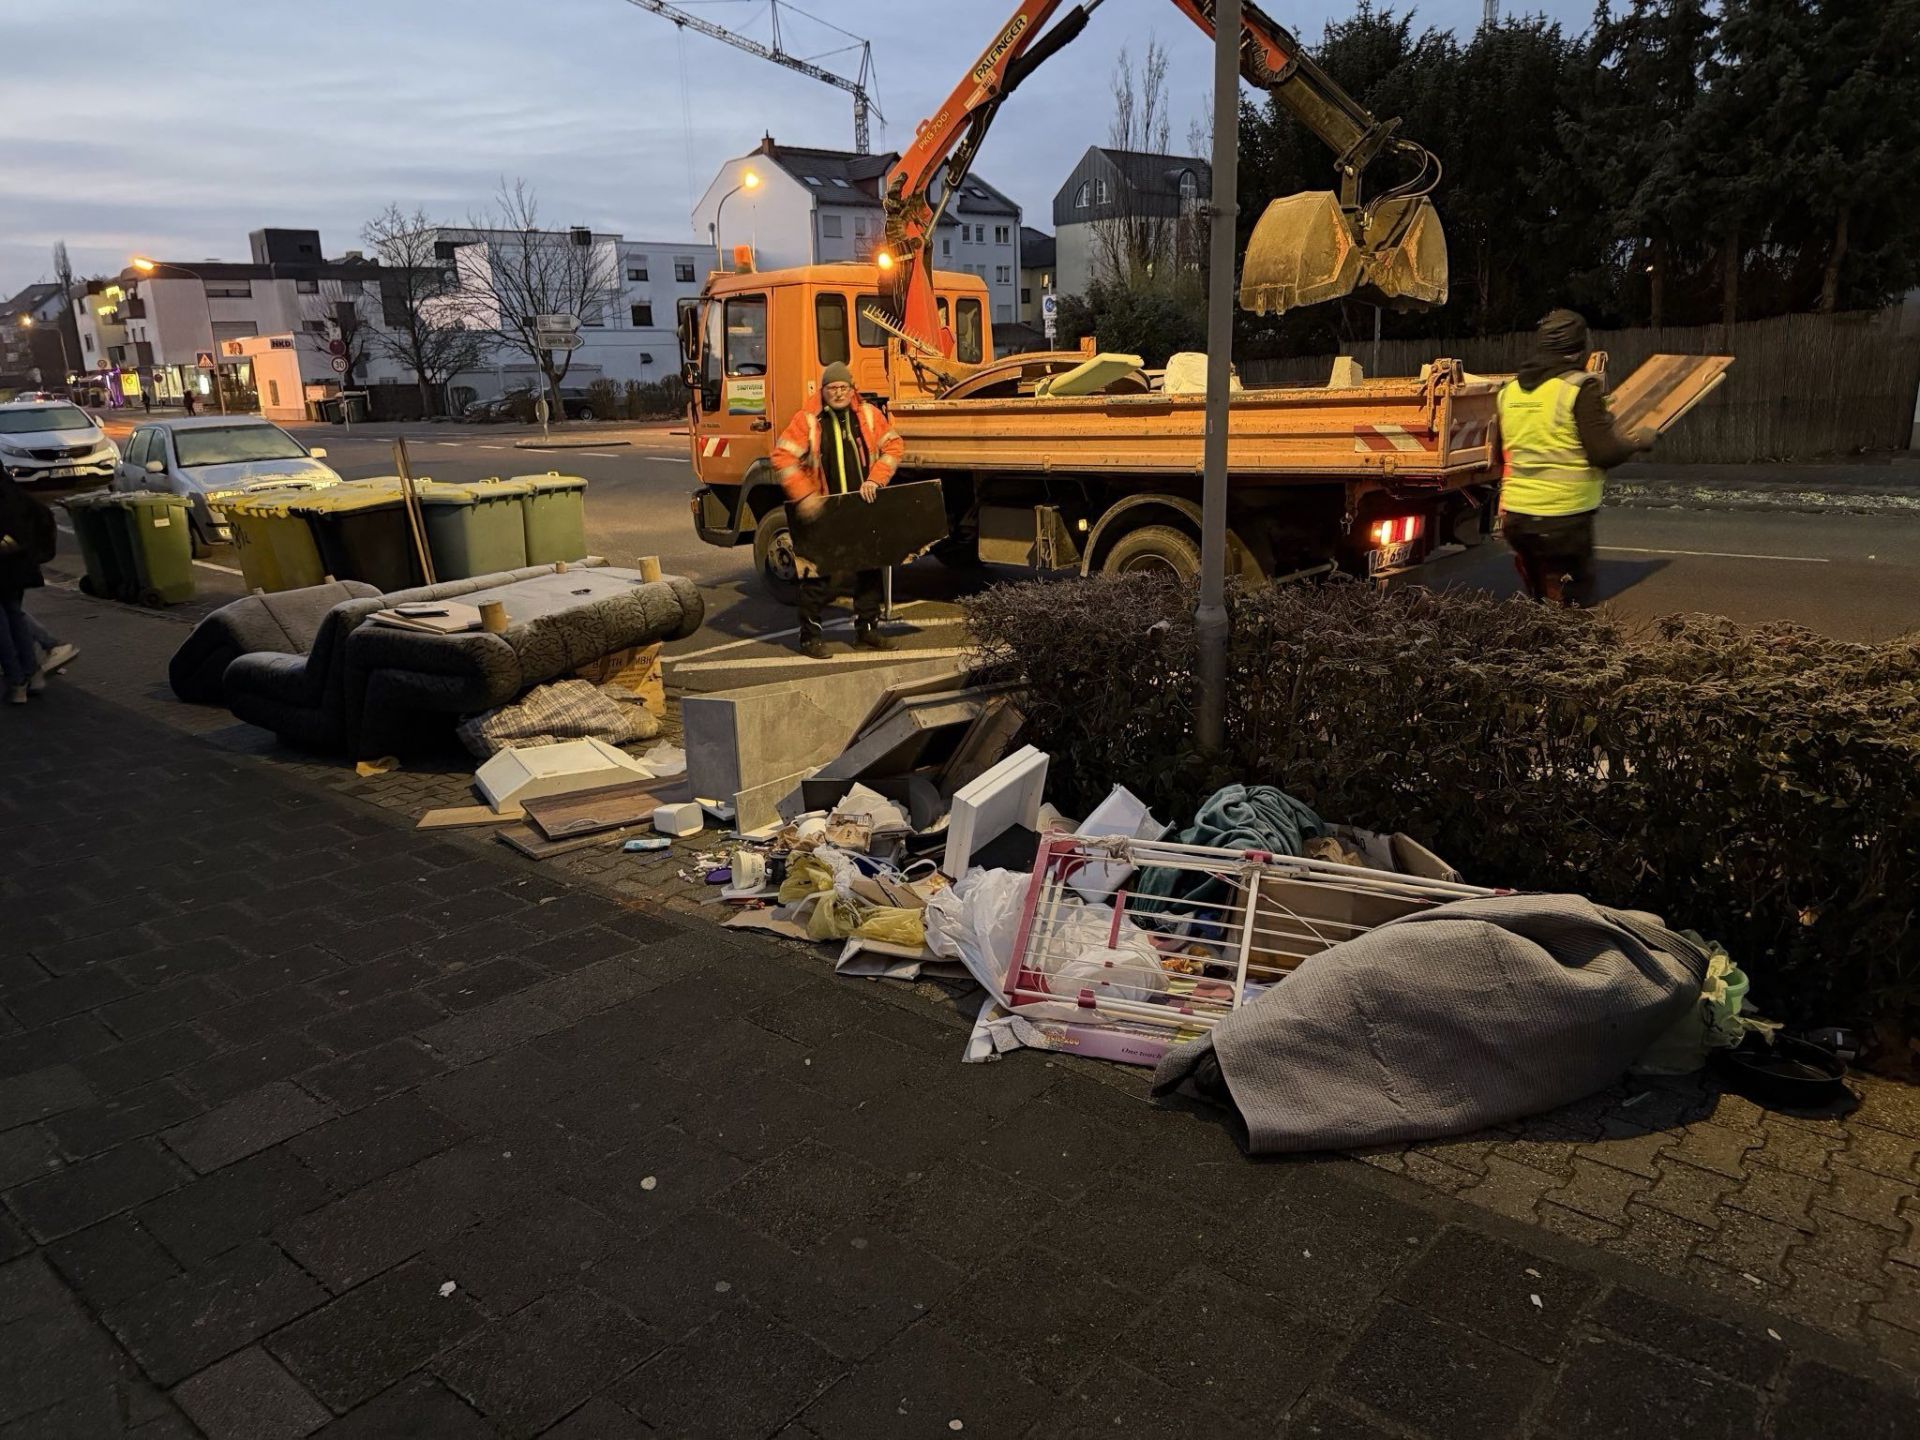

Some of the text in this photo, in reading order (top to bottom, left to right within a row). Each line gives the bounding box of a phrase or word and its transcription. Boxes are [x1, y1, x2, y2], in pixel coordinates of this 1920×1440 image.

[975, 18, 1026, 79] PALFINGER
[271, 340, 291, 349] NKD
[335, 360, 345, 369] 30
